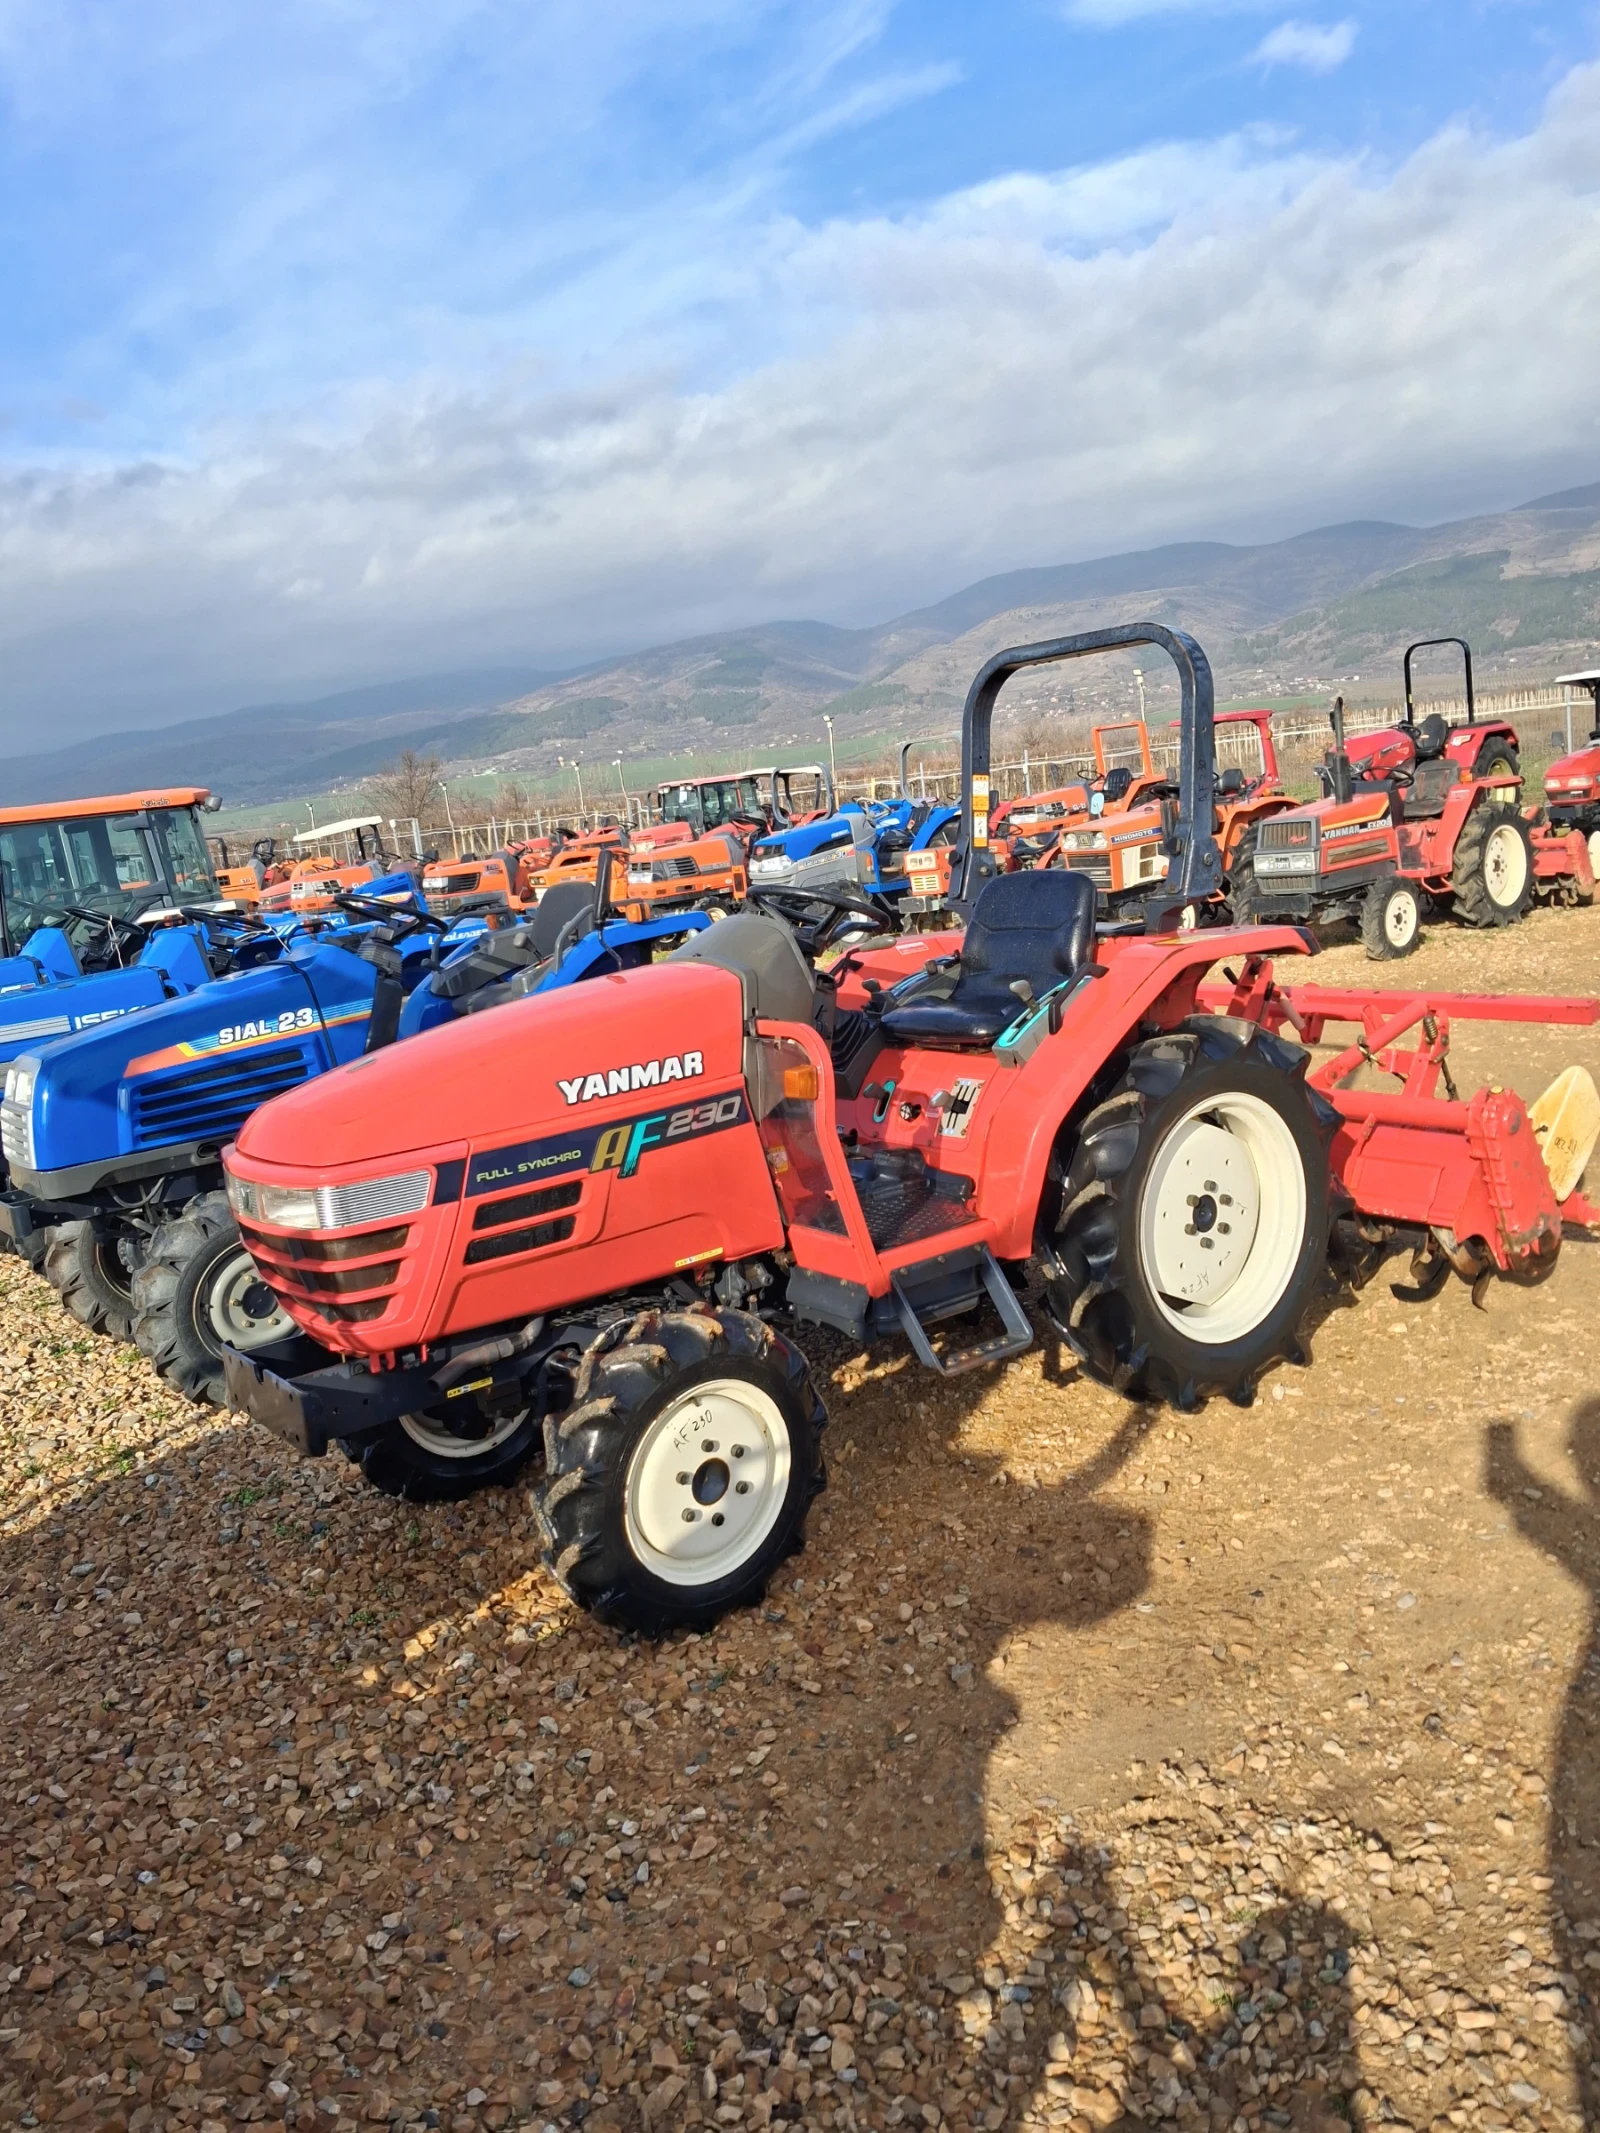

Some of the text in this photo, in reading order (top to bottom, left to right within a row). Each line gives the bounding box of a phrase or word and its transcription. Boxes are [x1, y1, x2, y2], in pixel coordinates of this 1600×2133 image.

[1113, 829, 1154, 843] HINOMOTO
[1323, 824, 1360, 840] YANMAR
[74, 1004, 147, 1031] ISE
[219, 1007, 313, 1045] SIAL 23
[557, 1050, 704, 1105] YANMAR
[476, 1167, 514, 1182] FULL
[517, 1149, 582, 1173] SYNCHRO
